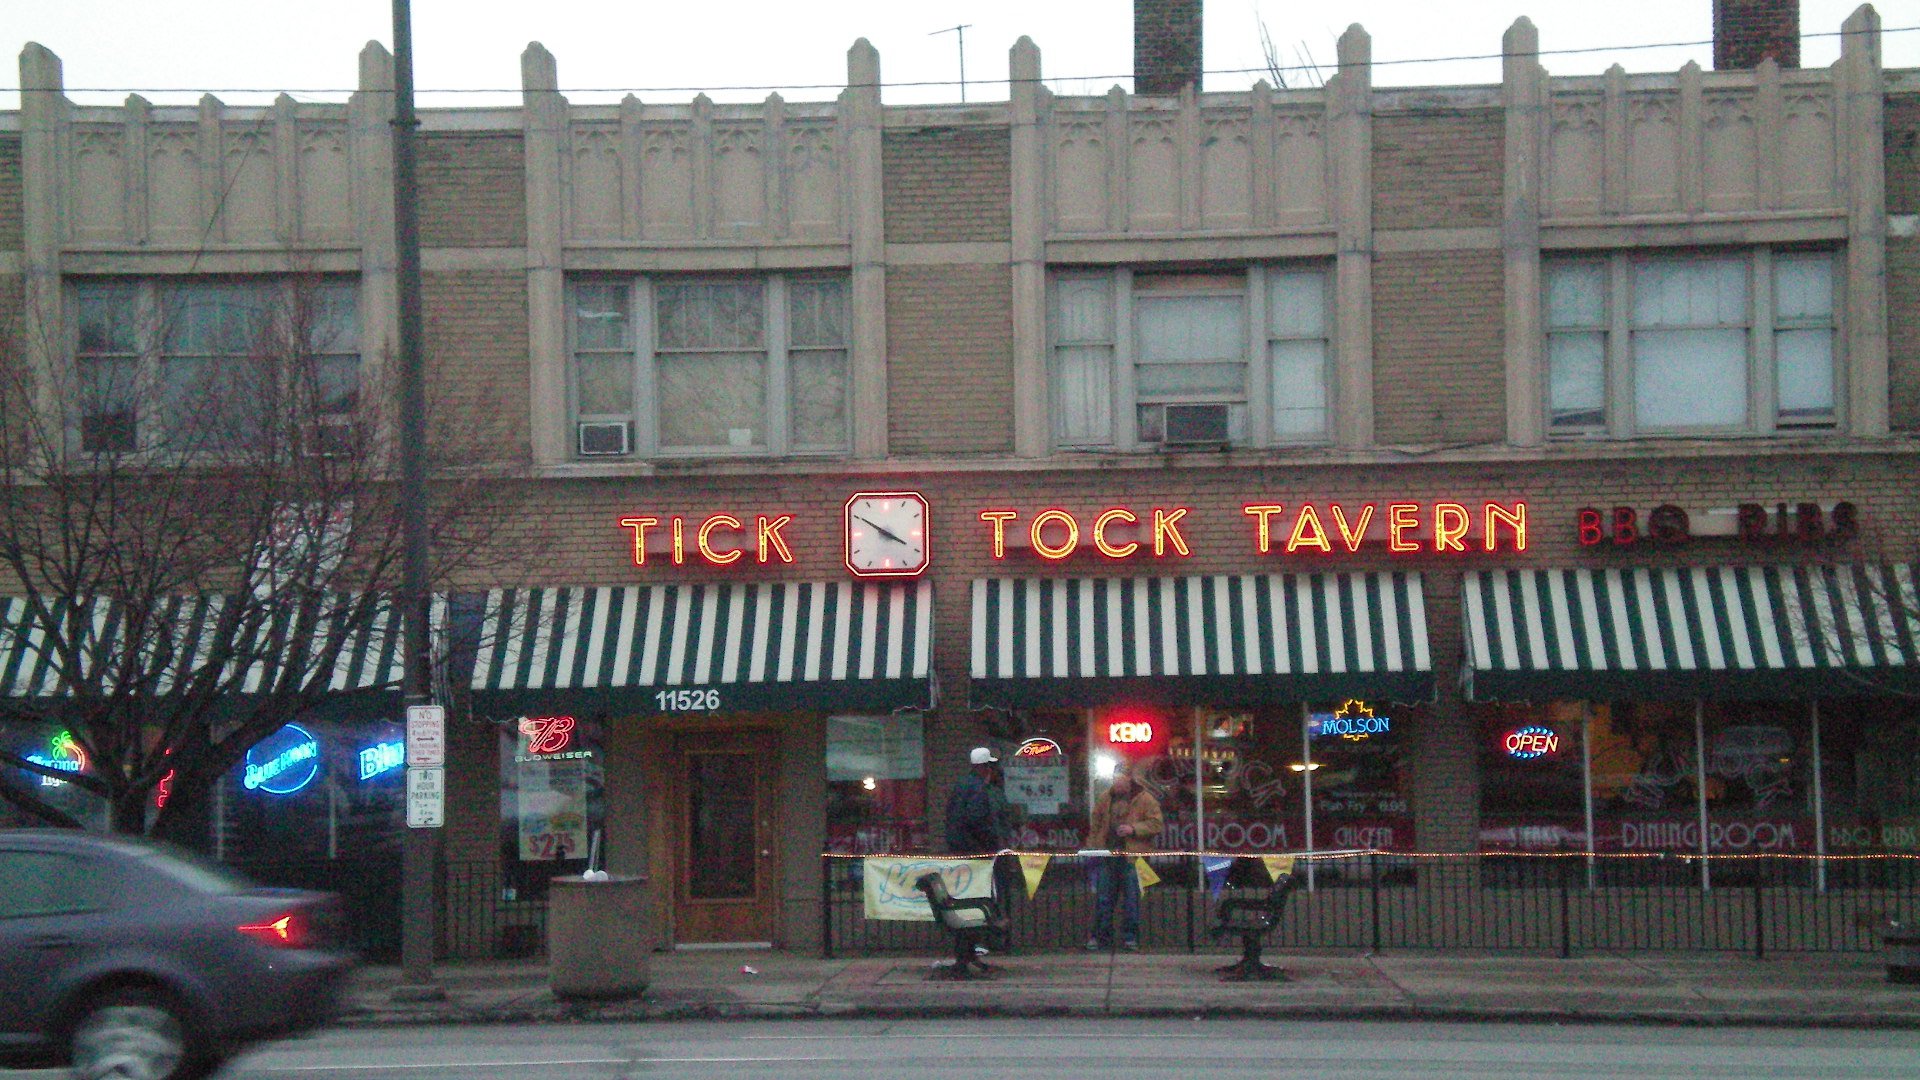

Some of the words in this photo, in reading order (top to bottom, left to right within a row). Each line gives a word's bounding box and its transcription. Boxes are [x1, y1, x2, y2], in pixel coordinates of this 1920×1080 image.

[980, 508, 1191, 560] TOCK
[1244, 502, 1529, 554] TAVERN
[1578, 504, 1690, 546] BBQ
[1737, 501, 1860, 543] RIBS
[620, 515, 794, 565] TICK
[655, 688, 720, 711] 11526
[418, 710, 433, 720] NO
[1321, 717, 1390, 736] MOLSON
[1109, 721, 1153, 743] KENO
[1505, 733, 1559, 753] OPEN
[514, 750, 593, 763] BUDWEISER
[410, 791, 440, 800] PARKING
[1207, 822, 1288, 848] ROOM
[1621, 822, 1698, 849] DINING
[1710, 822, 1796, 848] ROOM
